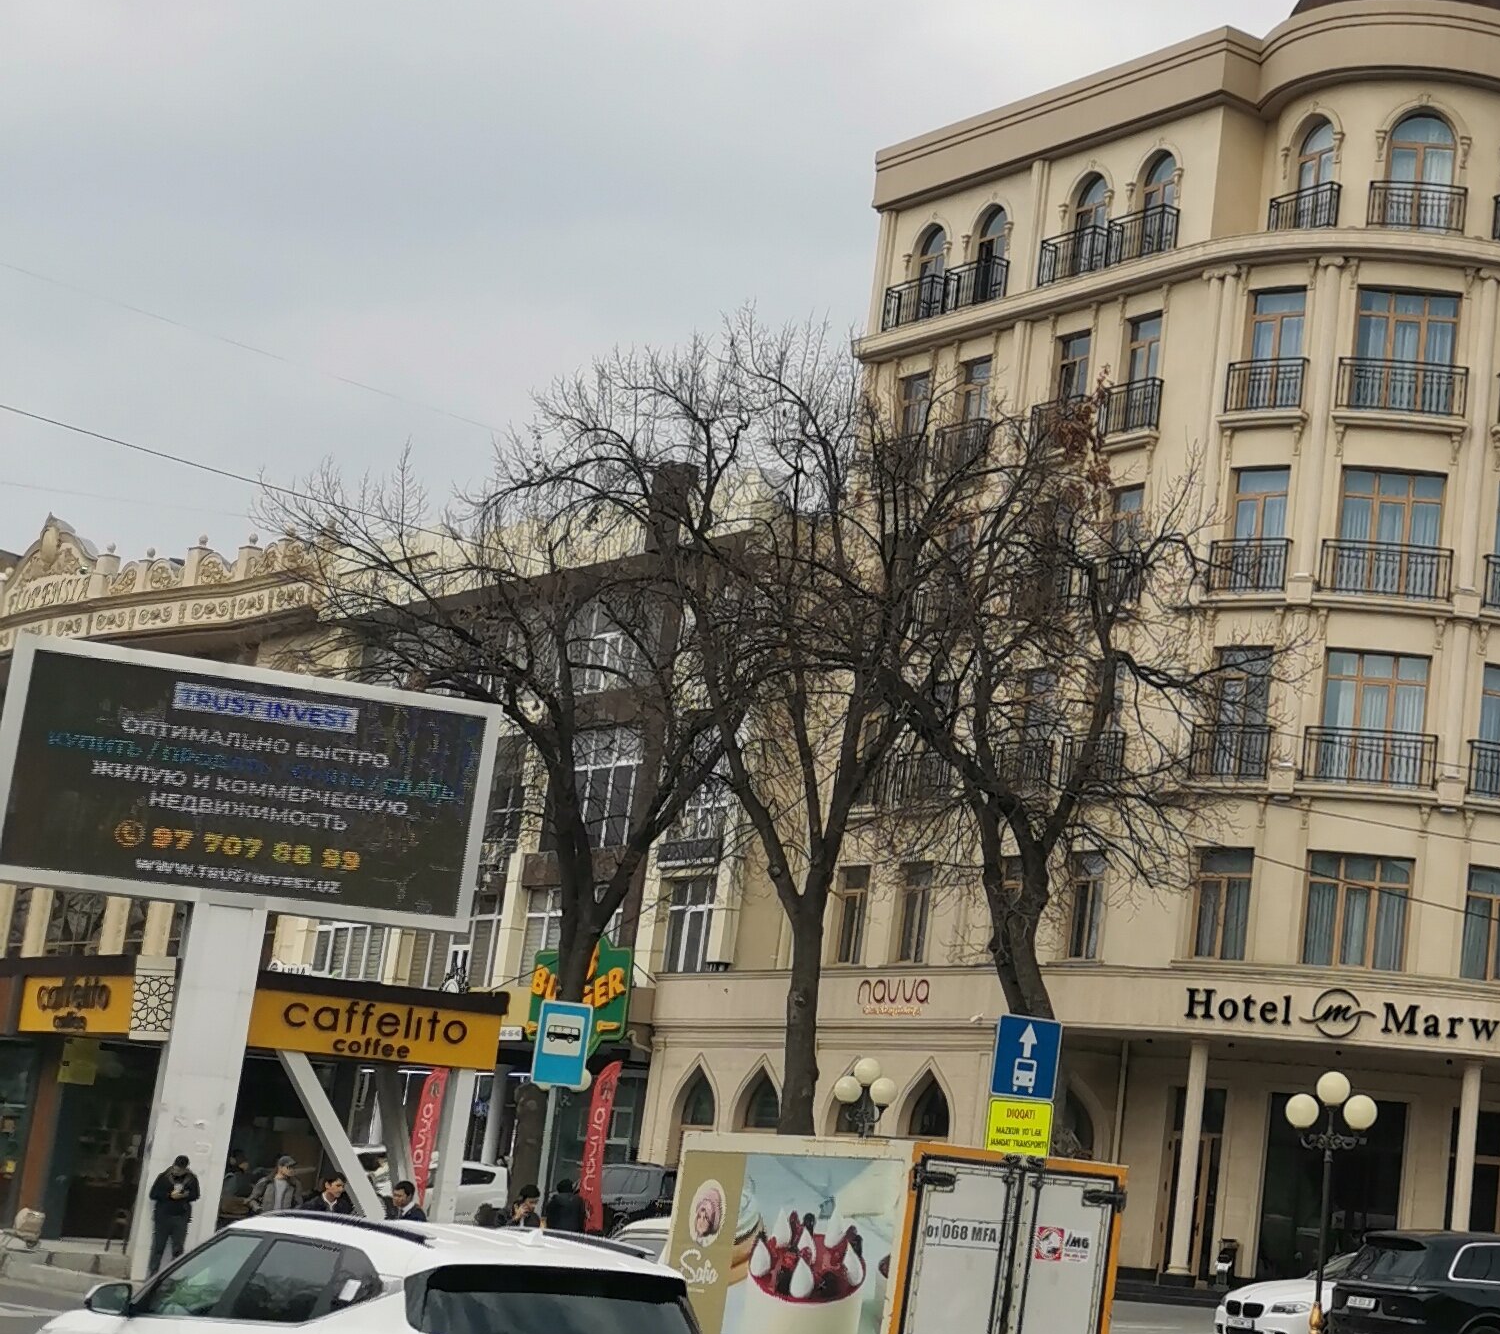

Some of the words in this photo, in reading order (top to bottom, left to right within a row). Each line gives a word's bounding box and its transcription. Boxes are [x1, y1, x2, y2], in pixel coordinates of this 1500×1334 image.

[182, 687, 261, 716] TRUST
[266, 698, 354, 728] INVEST
[120, 716, 290, 755] ОПТИМАЛЬНО
[296, 740, 390, 768] БЫСТРО
[91, 759, 187, 787] ЖИЛУЮ
[193, 772, 210, 790] И
[214, 776, 408, 815] КОММЕРЧЕСКУЮ
[149, 790, 348, 832] НЕДВИЖИМОСТЬ
[152, 825, 195, 850] 97
[203, 831, 264, 859] 707
[272, 841, 312, 865] 88
[321, 848, 361, 871] 99
[857, 978, 931, 1005] navva
[1184, 988, 1292, 1026] Hotel
[283, 1000, 468, 1044] caffelito
[332, 1037, 410, 1059] coffee
[926, 1225, 939, 1238] 01
[942, 1224, 968, 1241] 068
[971, 1226, 997, 1243] MFA
